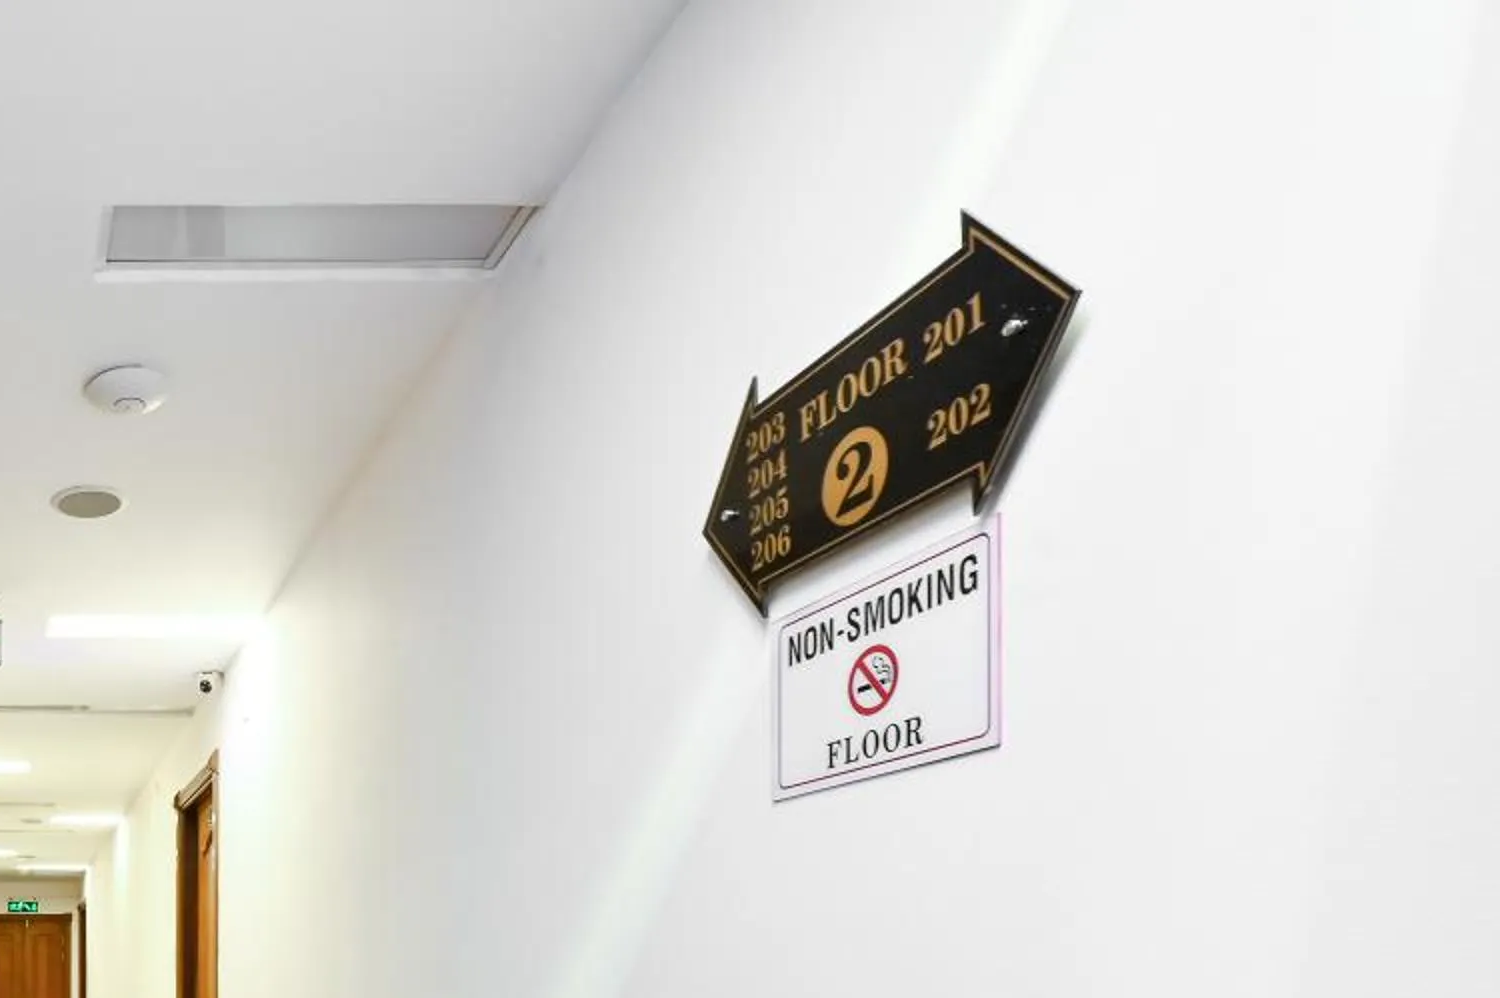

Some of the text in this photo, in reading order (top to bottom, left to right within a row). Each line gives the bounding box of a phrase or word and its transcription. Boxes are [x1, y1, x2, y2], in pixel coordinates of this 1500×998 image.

[922, 291, 987, 364] 201
[797, 338, 909, 443] FLOOR
[926, 382, 993, 450] 202
[745, 411, 786, 461] 203
[746, 452, 788, 499] 204
[835, 440, 878, 519] 2
[748, 487, 790, 537] 205
[750, 526, 792, 573] 206
[788, 554, 979, 667] NON-SMOKING
[826, 716, 925, 769] FLOOR
